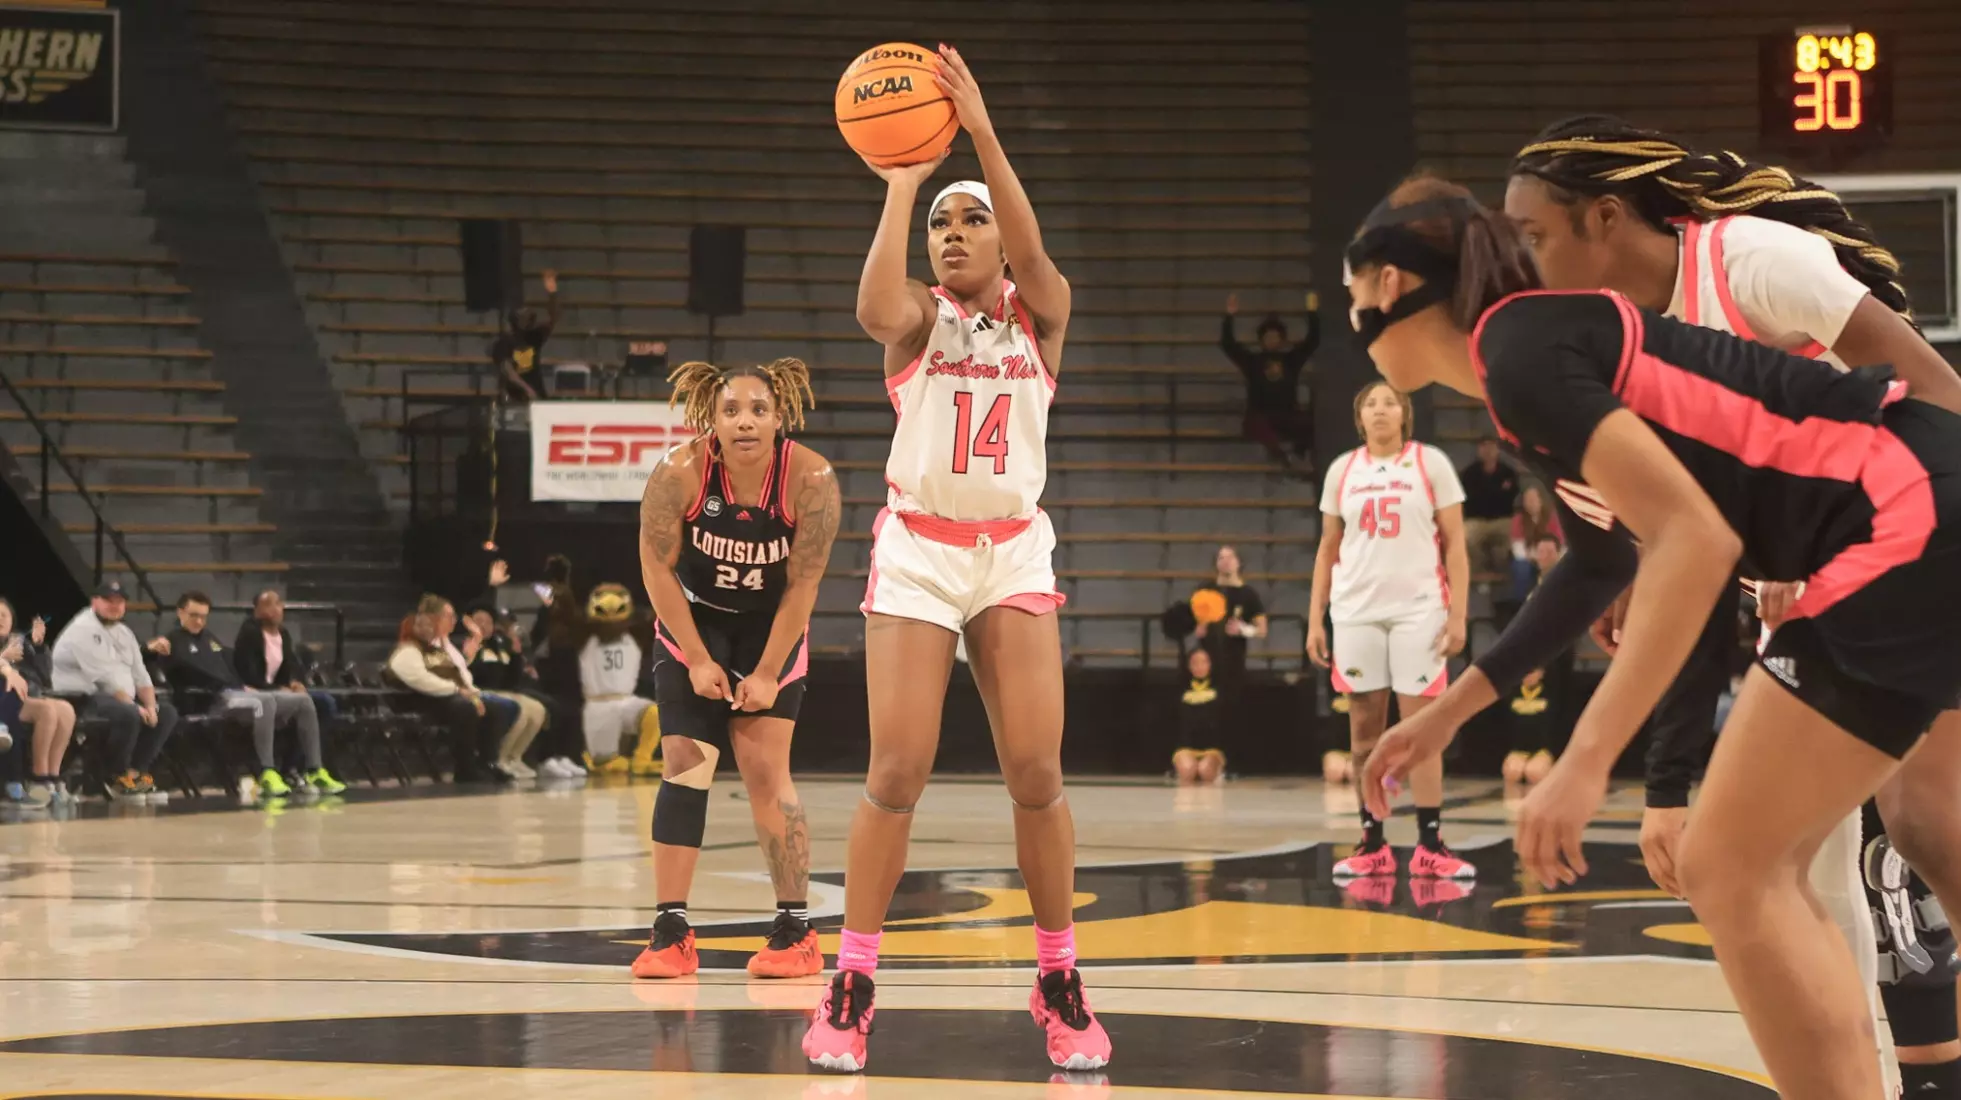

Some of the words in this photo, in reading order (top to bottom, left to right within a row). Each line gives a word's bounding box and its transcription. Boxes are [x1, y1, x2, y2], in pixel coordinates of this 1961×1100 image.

[0, 28, 102, 71] HERN
[1796, 32, 1876, 72] 8:43
[853, 75, 914, 105] NCAA
[1794, 69, 1861, 131] 30
[926, 350, 1000, 381] Southern
[951, 391, 1012, 475] 14
[706, 500, 721, 512] GS
[1358, 497, 1401, 540] 45
[692, 526, 790, 565] LOUISIANA
[714, 565, 764, 590] 24
[603, 649, 624, 671] 30
